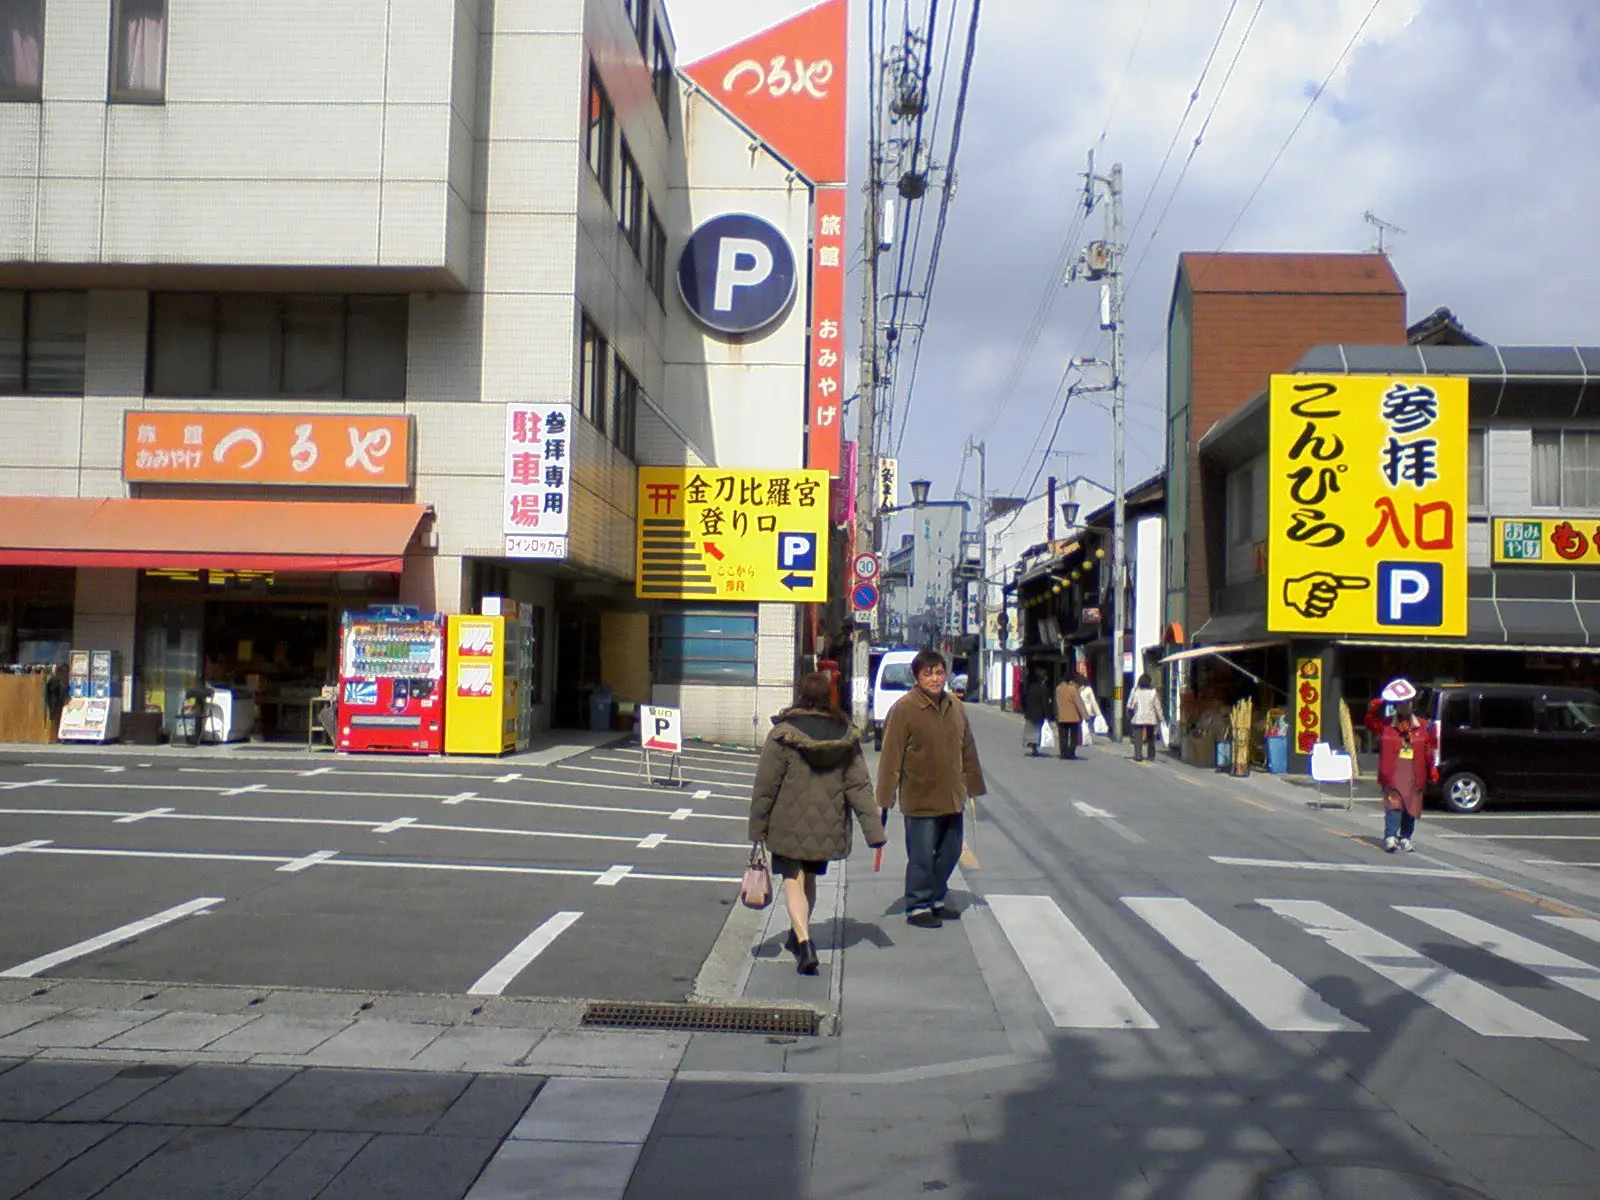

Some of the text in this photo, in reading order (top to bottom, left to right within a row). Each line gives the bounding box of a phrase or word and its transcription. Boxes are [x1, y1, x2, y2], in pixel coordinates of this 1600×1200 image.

[722, 54, 834, 98] つるや
[819, 214, 842, 267] 旅館
[713, 236, 774, 312] P
[817, 320, 839, 427] おみやげ
[212, 423, 393, 473] つるや
[1382, 384, 1438, 488] 参拝
[510, 410, 542, 528] 駐車場
[543, 410, 567, 514] 参拝専用
[1286, 382, 1348, 548] こんぴら
[685, 474, 821, 508] 金刀比羅宮
[507, 538, 562, 553] コインロッカー
[699, 506, 777, 538] 登り口
[1366, 496, 1454, 550] 入口
[717, 566, 756, 578] ここから
[783, 536, 811, 566] P
[858, 560, 874, 573] 30
[1389, 569, 1430, 620] P
[655, 718, 670, 736] P
